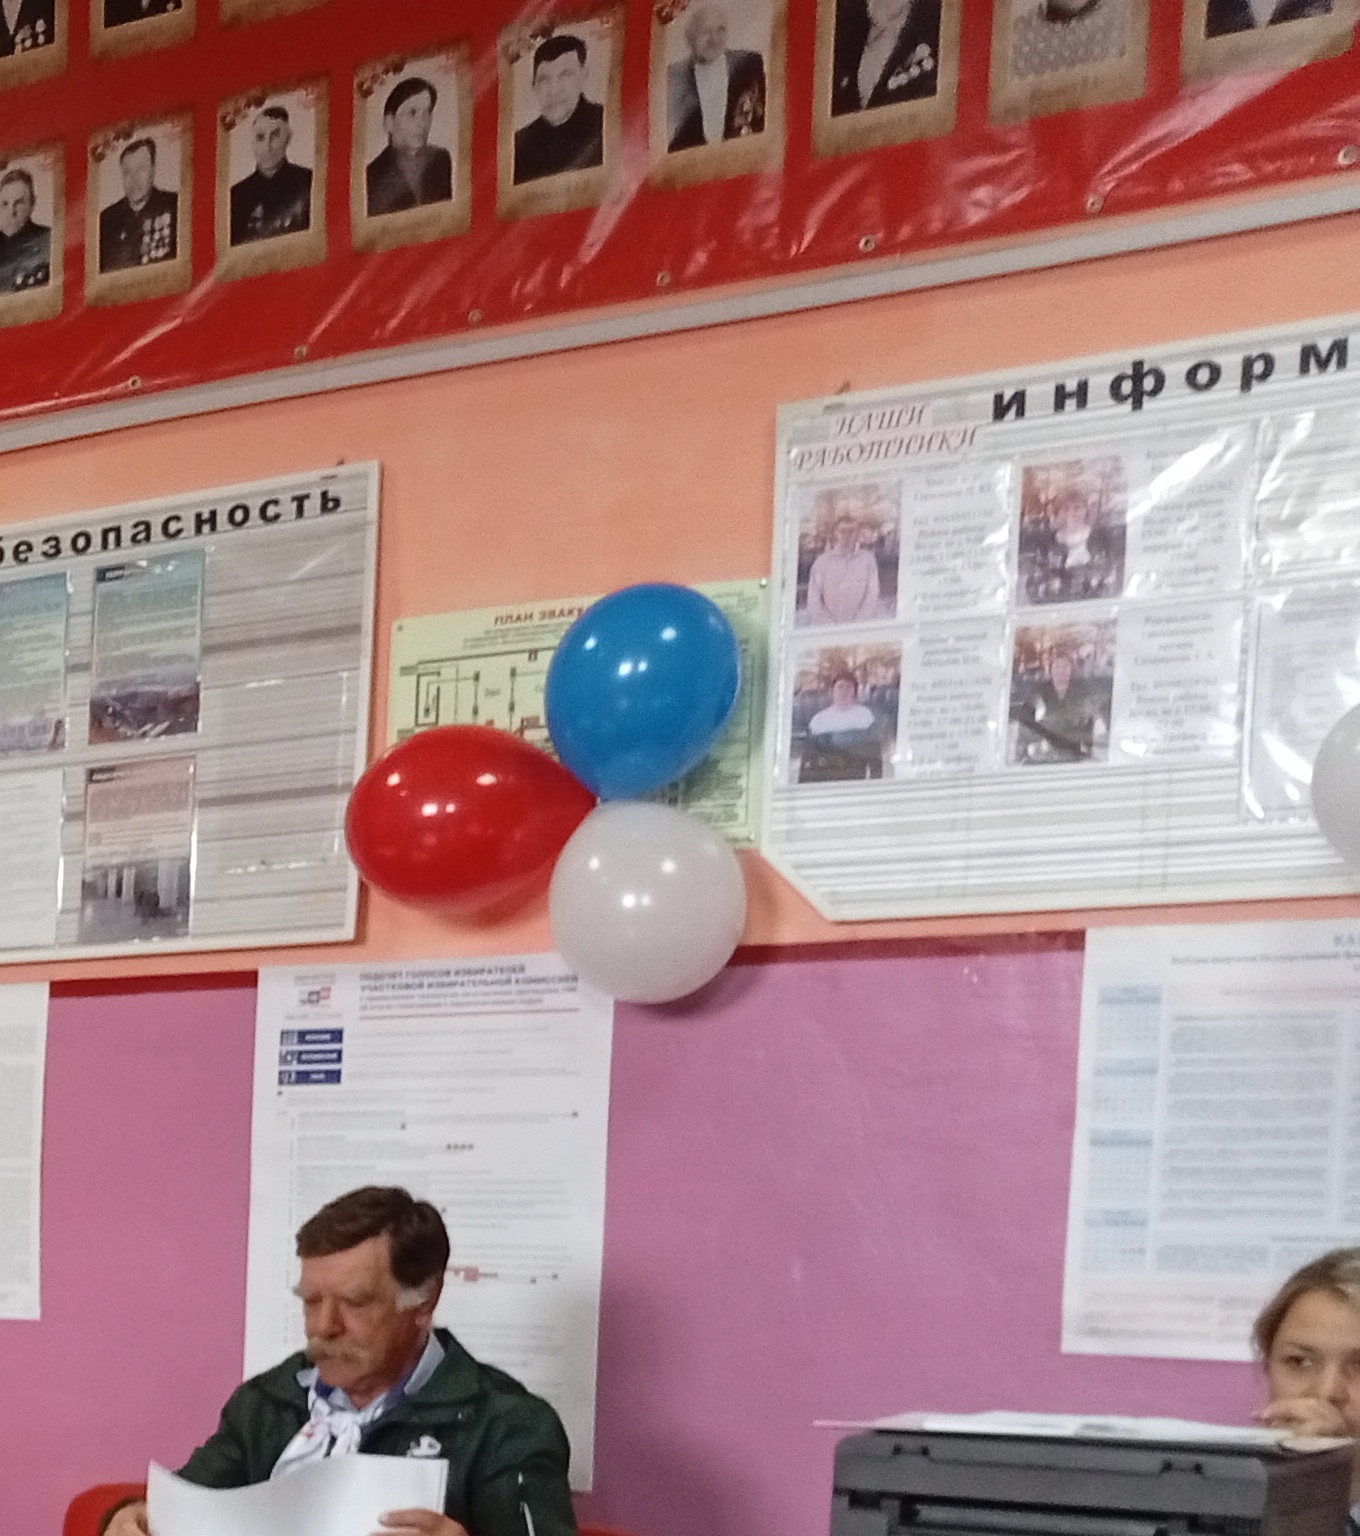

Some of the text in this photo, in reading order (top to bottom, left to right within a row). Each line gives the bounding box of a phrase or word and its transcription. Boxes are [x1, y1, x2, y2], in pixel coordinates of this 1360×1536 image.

[834, 405, 926, 437] НАШИ
[794, 424, 981, 471] РАБОТНИКИ
[494, 612, 533, 625] ПЛАН
